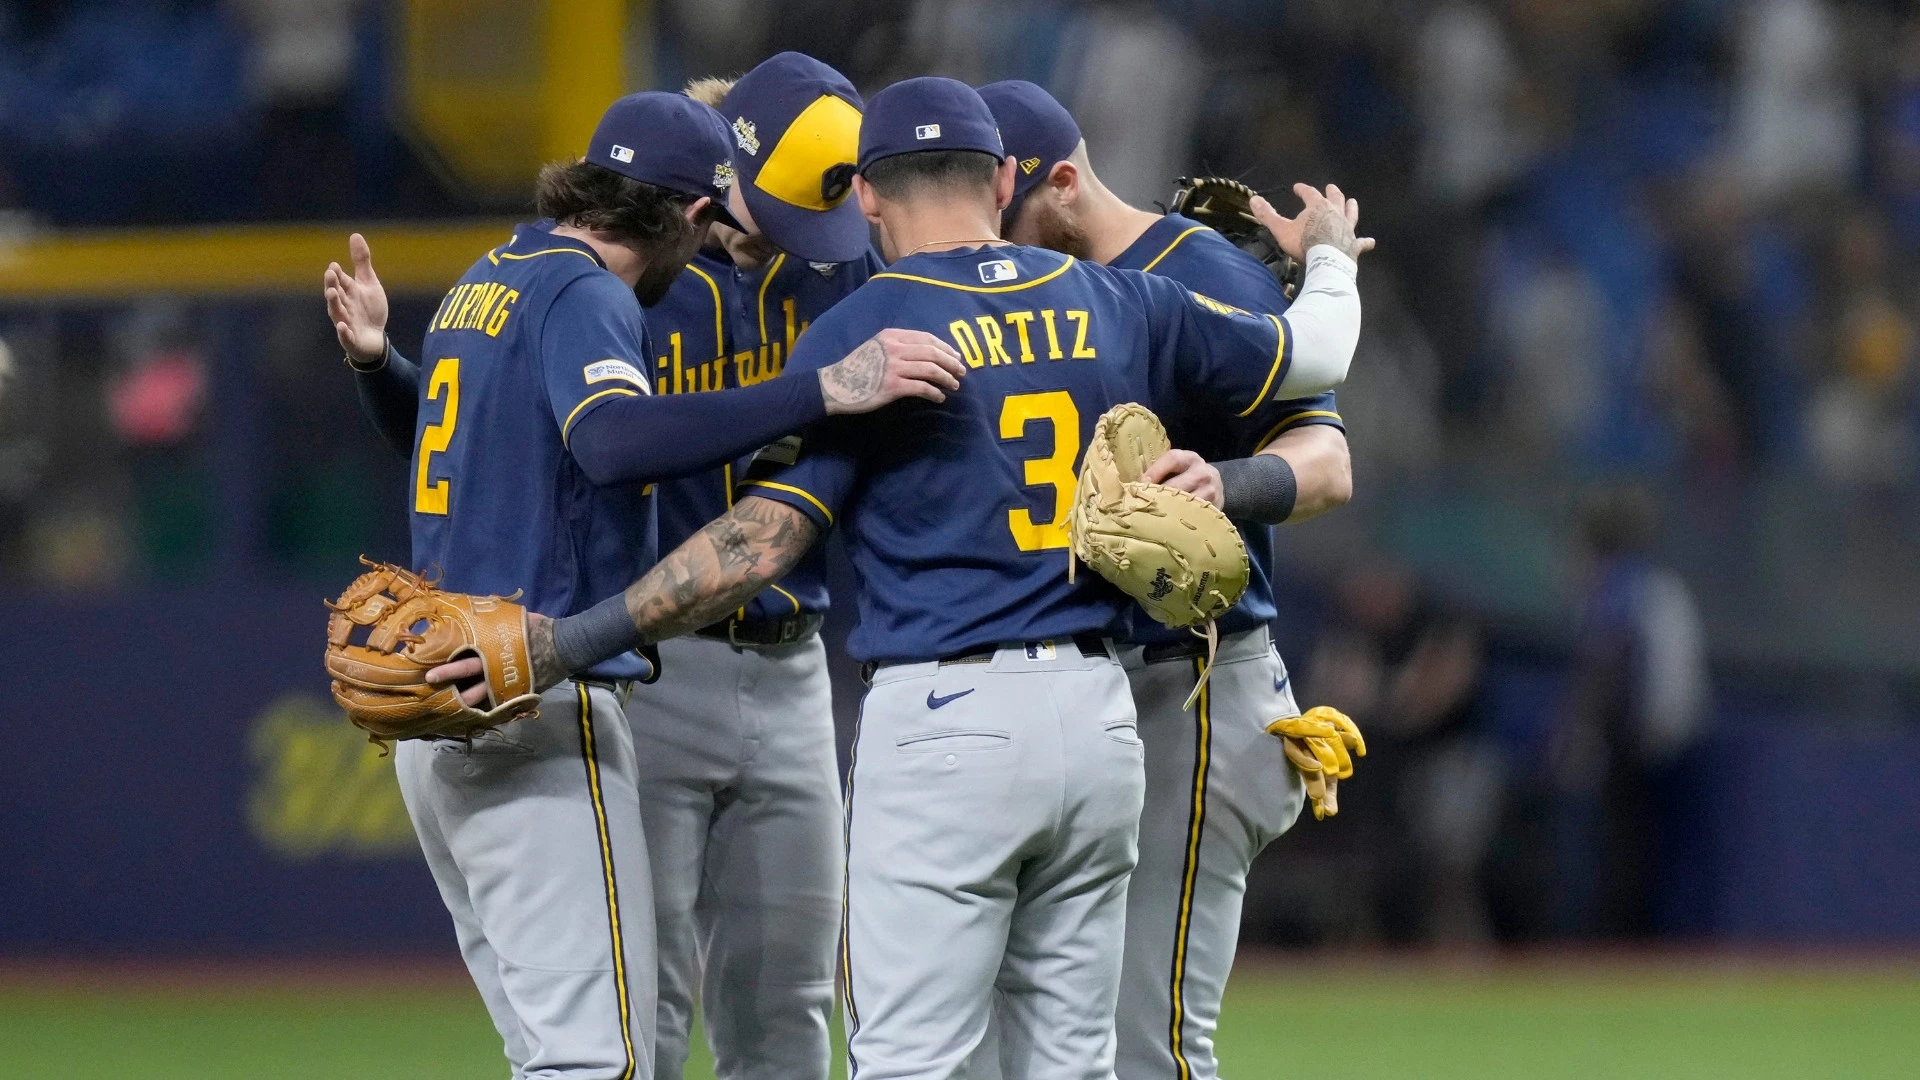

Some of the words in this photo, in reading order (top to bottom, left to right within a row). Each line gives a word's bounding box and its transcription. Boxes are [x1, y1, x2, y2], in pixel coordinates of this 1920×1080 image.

[949, 309, 1096, 369] ORTIZ
[415, 358, 460, 515] 2
[999, 390, 1080, 552] 3
